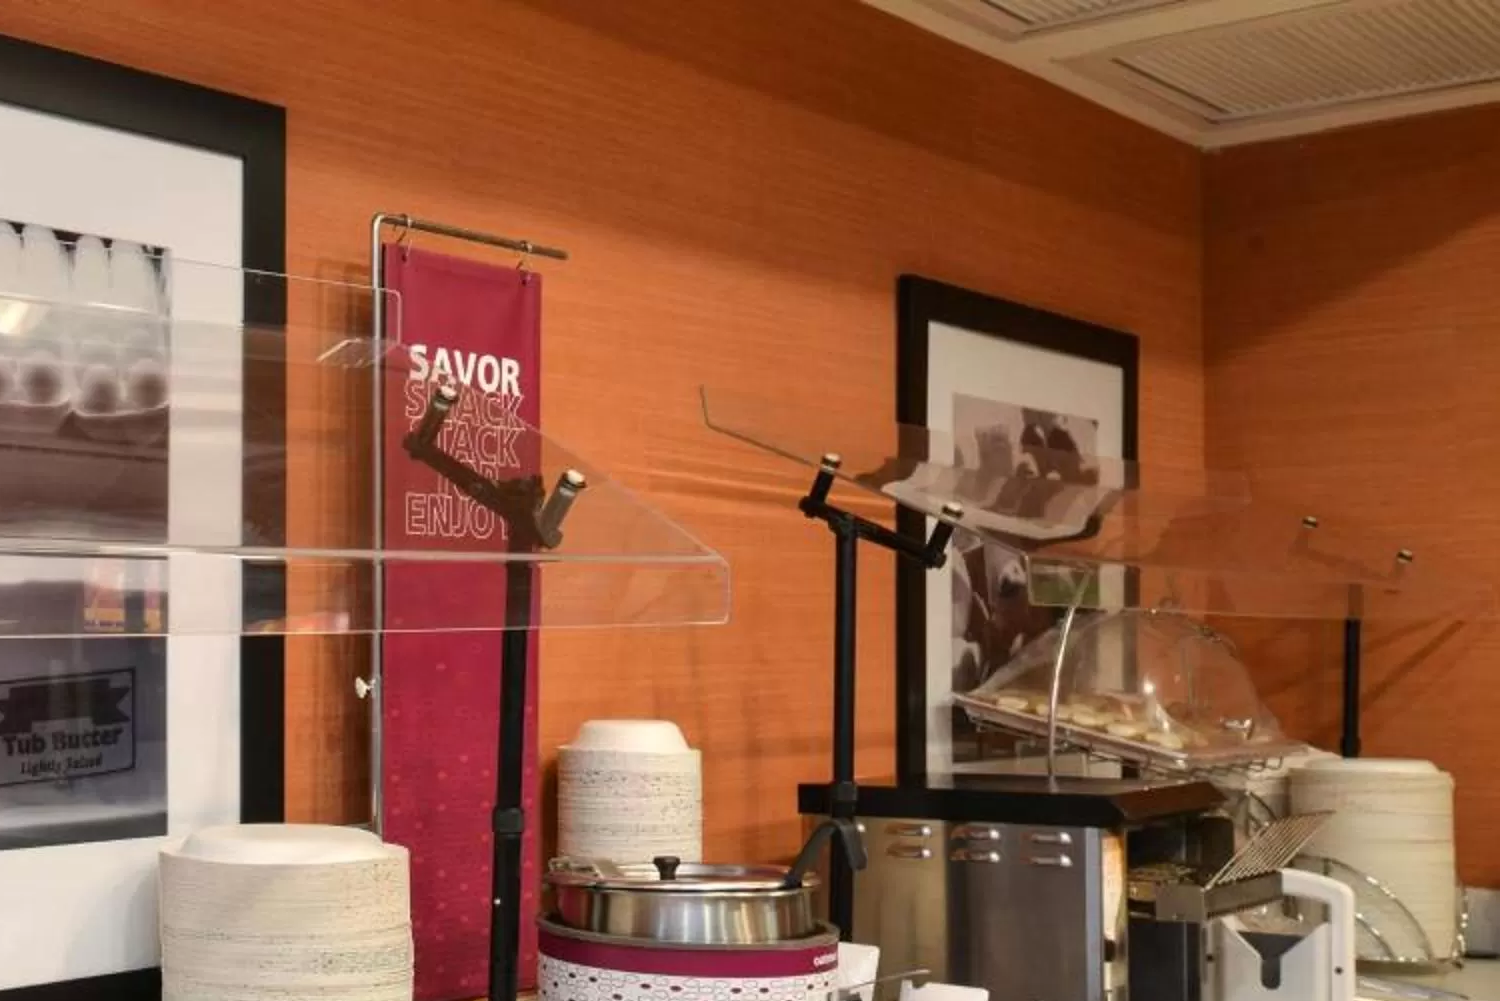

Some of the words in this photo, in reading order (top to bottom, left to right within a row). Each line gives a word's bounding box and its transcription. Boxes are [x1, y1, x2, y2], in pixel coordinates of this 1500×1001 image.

[409, 344, 521, 397] SAVOR
[405, 379, 524, 430] SACK
[408, 419, 521, 468] TACK
[405, 491, 509, 540] ENJO
[3, 733, 46, 756] Tub
[51, 727, 124, 751] Butter
